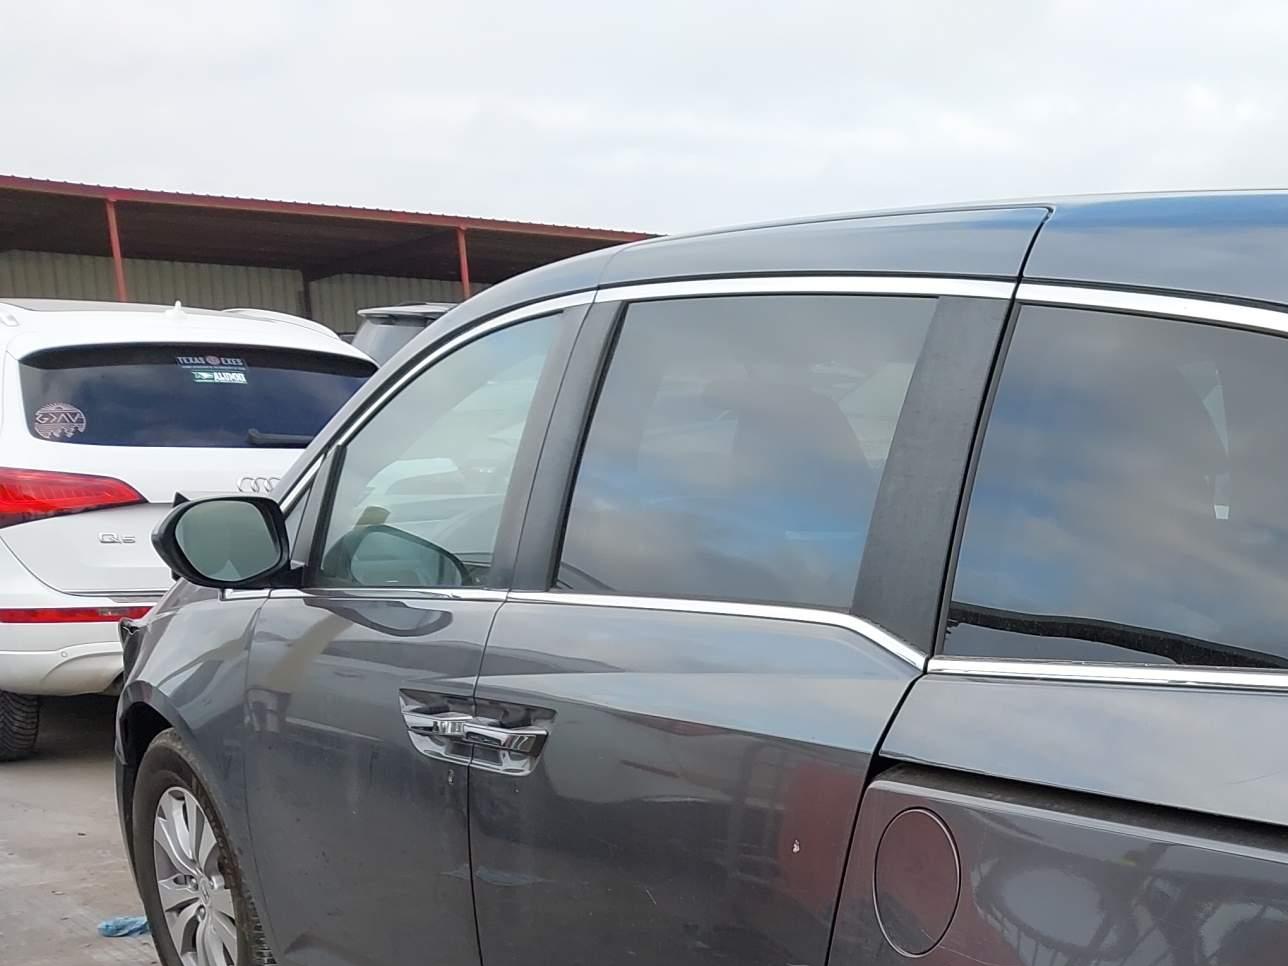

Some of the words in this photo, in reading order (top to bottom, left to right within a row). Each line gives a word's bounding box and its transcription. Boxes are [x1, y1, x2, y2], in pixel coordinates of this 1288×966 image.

[176, 356, 206, 365] TEXAS
[220, 357, 243, 366] EXES
[98, 532, 136, 545] Q5
